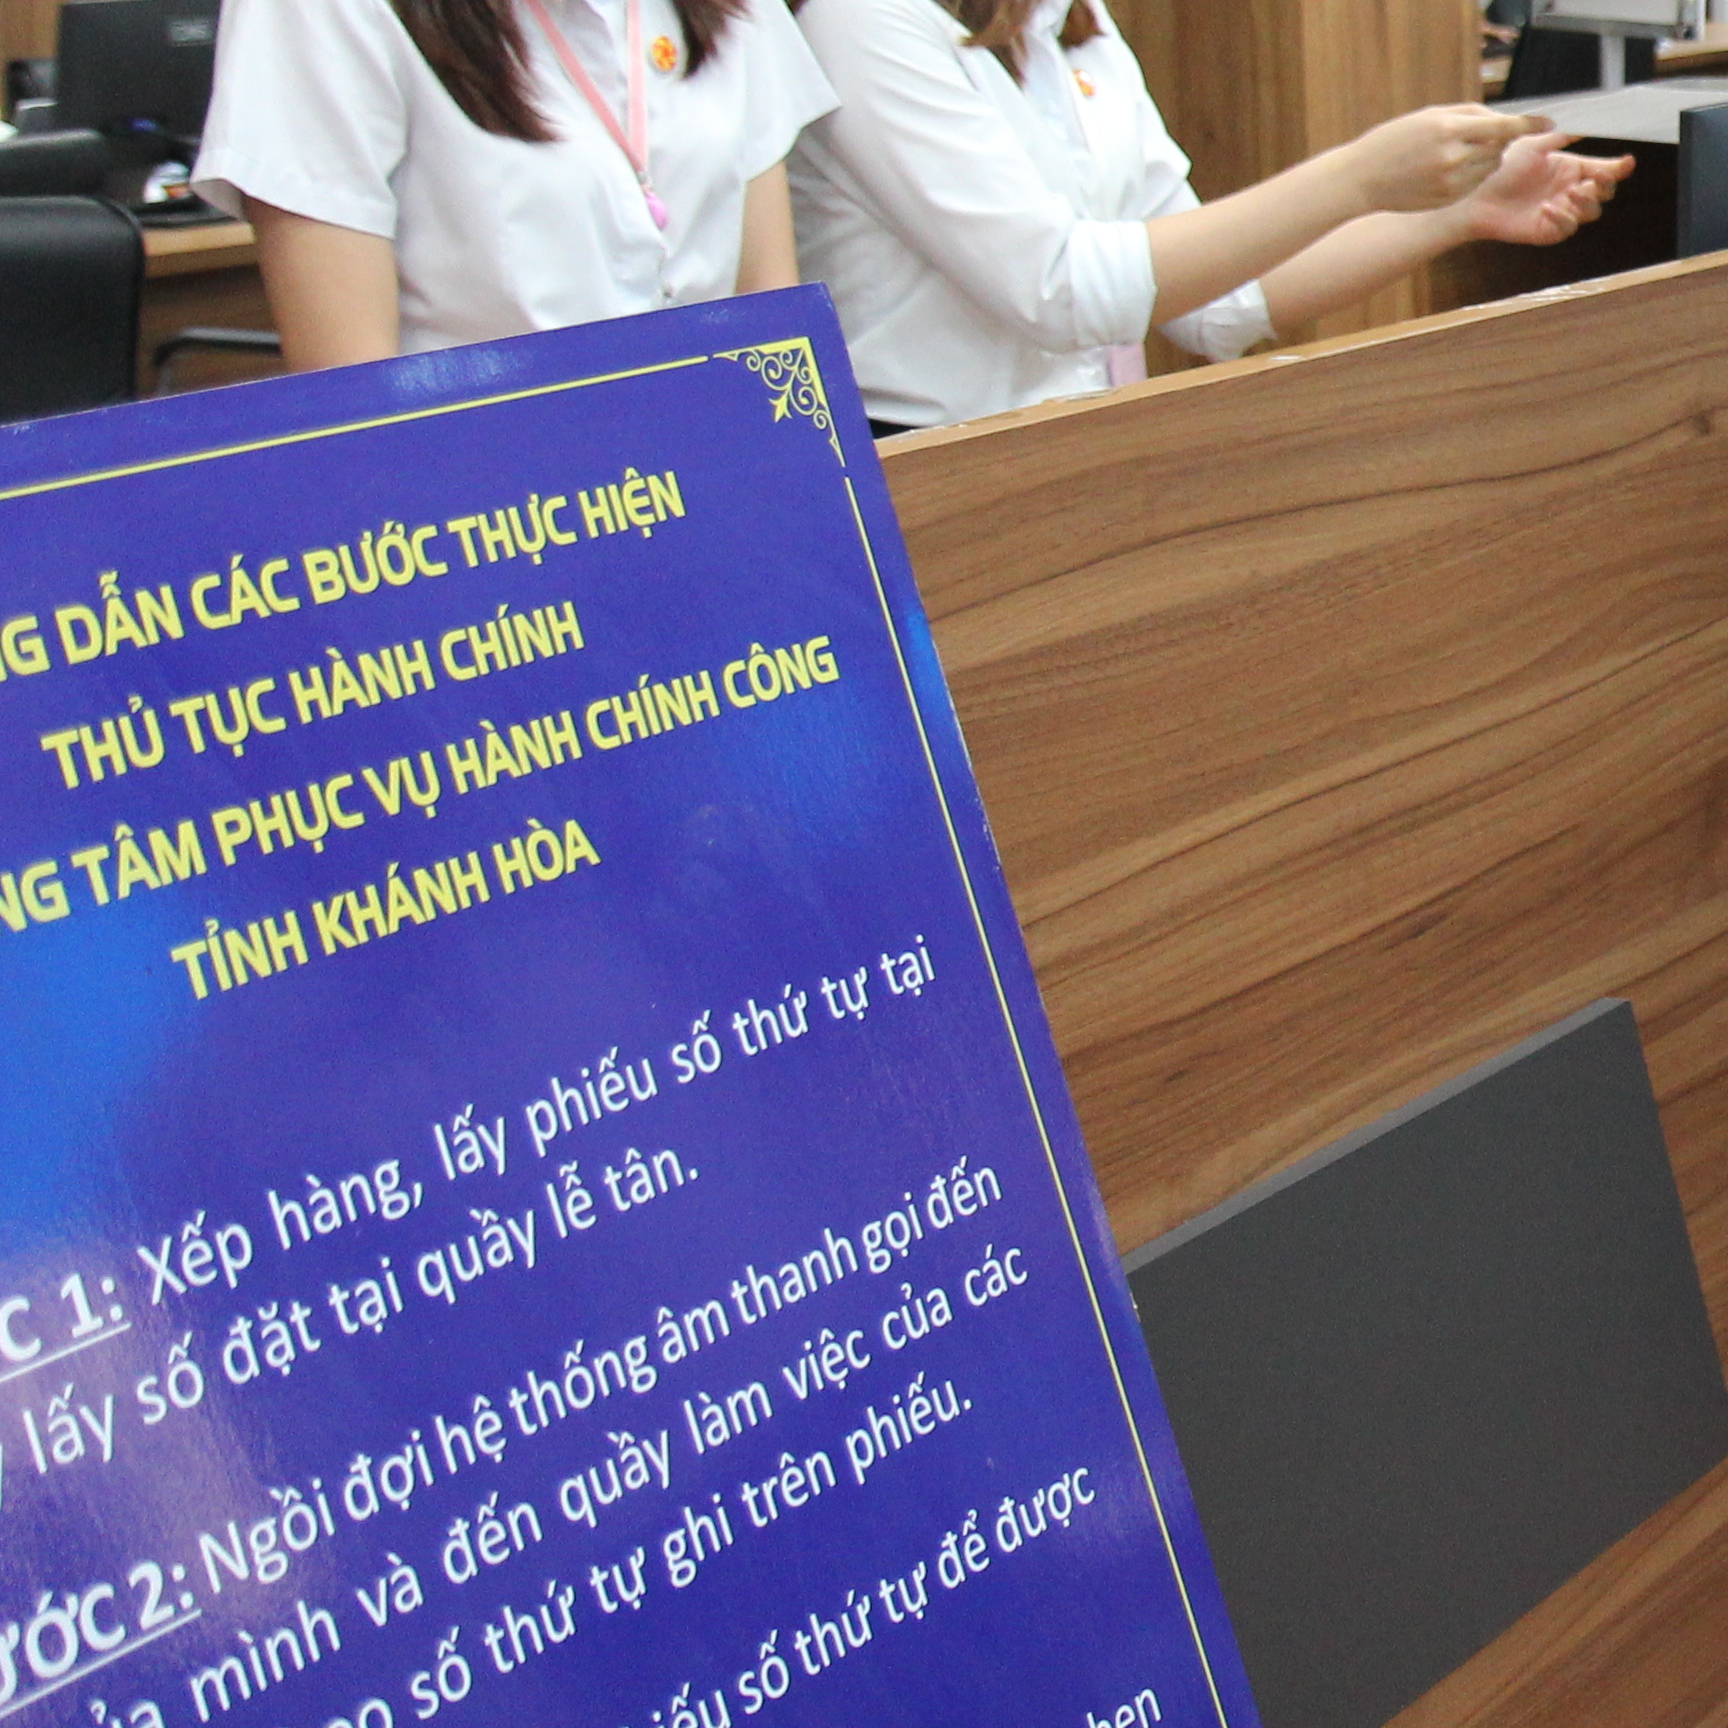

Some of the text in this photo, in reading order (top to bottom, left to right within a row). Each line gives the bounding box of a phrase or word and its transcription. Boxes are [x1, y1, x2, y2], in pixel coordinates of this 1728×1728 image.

[39, 600, 586, 790] THỦ TỤC HÀNH CHÍNH
[54, 569, 185, 666] DẪN
[190, 553, 301, 631] CÁC
[302, 519, 450, 606] BƯỚC
[446, 492, 578, 569] THỰC
[577, 466, 687, 540] HIỆN
[70, 818, 208, 908] TÂM
[210, 772, 366, 868] PHỤC
[361, 750, 442, 819] VỤ
[445, 709, 584, 796] HÀNH
[584, 669, 722, 751] CHÍNH
[721, 634, 841, 710] CÔNG
[170, 817, 602, 1001] TỈNH KHÁNH HÒA
[59, 1271, 124, 1339] 1:
[136, 1209, 254, 1306] Xếp
[267, 1156, 424, 1251] hàng,
[433, 1102, 506, 1181] lấy
[524, 1045, 659, 1158] phiếu
[669, 1009, 722, 1085] số
[731, 982, 811, 1057] thứ
[820, 966, 869, 1021] tự
[879, 933, 936, 997] tại
[22, 1146, 700, 1475] lấy số đặt tại quầy lễ tân.
[127, 1560, 195, 1631] 2:
[199, 1476, 336, 1594] Ngồi
[343, 1429, 435, 1522] đợi
[433, 1393, 508, 1475] hệ
[508, 1334, 659, 1436] thống
[657, 1298, 732, 1365] âm
[730, 1226, 860, 1324] thanh
[861, 1190, 925, 1275] gọi
[926, 1154, 1003, 1230] đến
[189, 1599, 342, 1724] mình
[355, 1551, 425, 1628] và
[442, 1490, 544, 1585] đến
[558, 1429, 670, 1529] quầy
[682, 1379, 774, 1455] làm
[781, 1326, 872, 1401] việc
[881, 1281, 954, 1351] của
[963, 1242, 1029, 1308] các
[409, 1370, 973, 1721] số thứ tự ghi trên phiếu.
[736, 1628, 791, 1715] số
[793, 1587, 874, 1677] thứ
[877, 1559, 930, 1624] tự
[936, 1507, 991, 1592] để
[994, 1465, 1097, 1554] được
